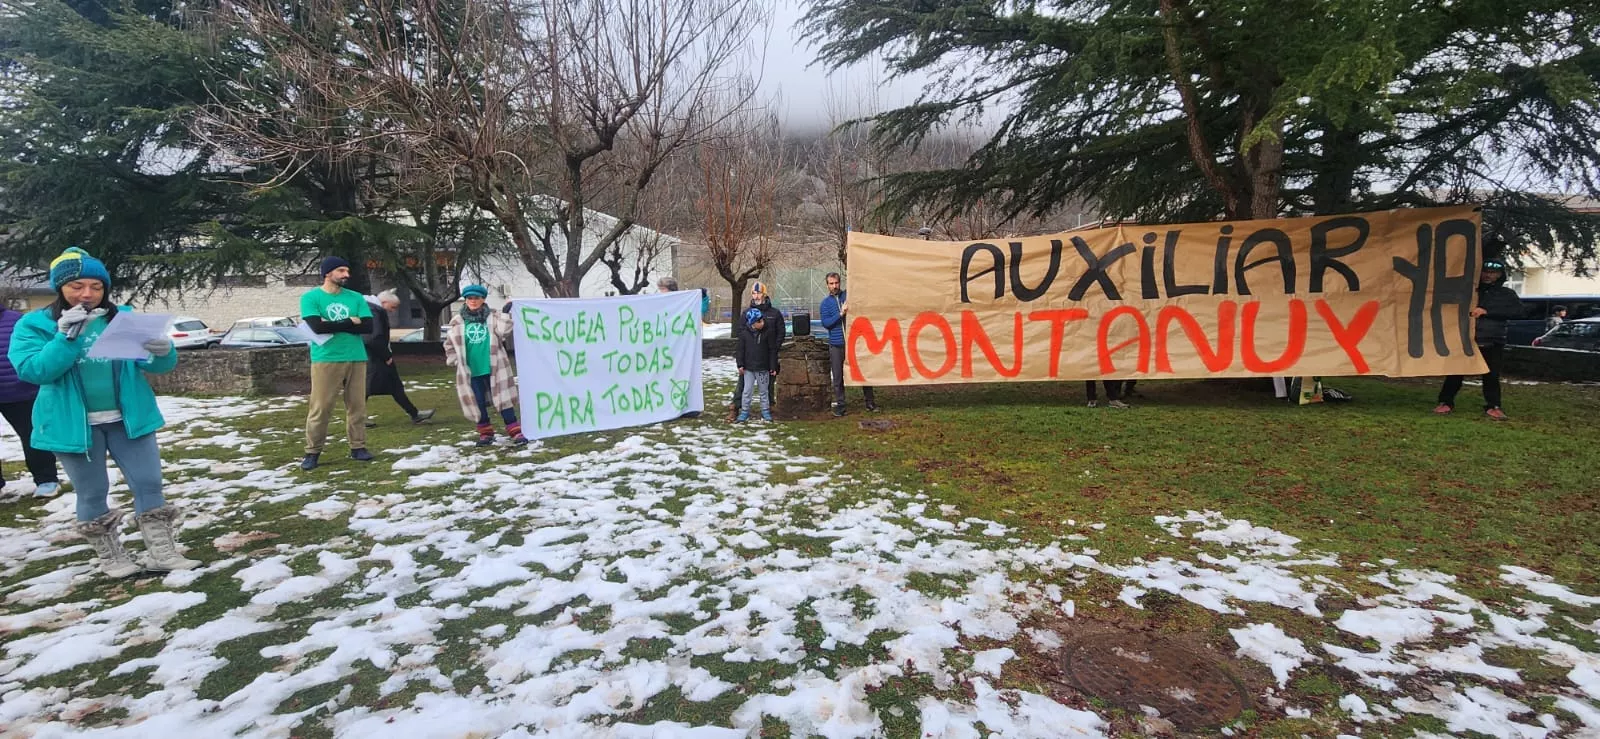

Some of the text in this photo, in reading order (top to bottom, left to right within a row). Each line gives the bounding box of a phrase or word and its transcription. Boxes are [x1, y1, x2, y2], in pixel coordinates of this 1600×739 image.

[1393, 218, 1476, 359] YA
[520, 306, 606, 345] ESCUELA
[848, 298, 1381, 382] MONTANUY
[557, 346, 674, 378] DE TODAS
[535, 381, 665, 432] PARA TODAS
